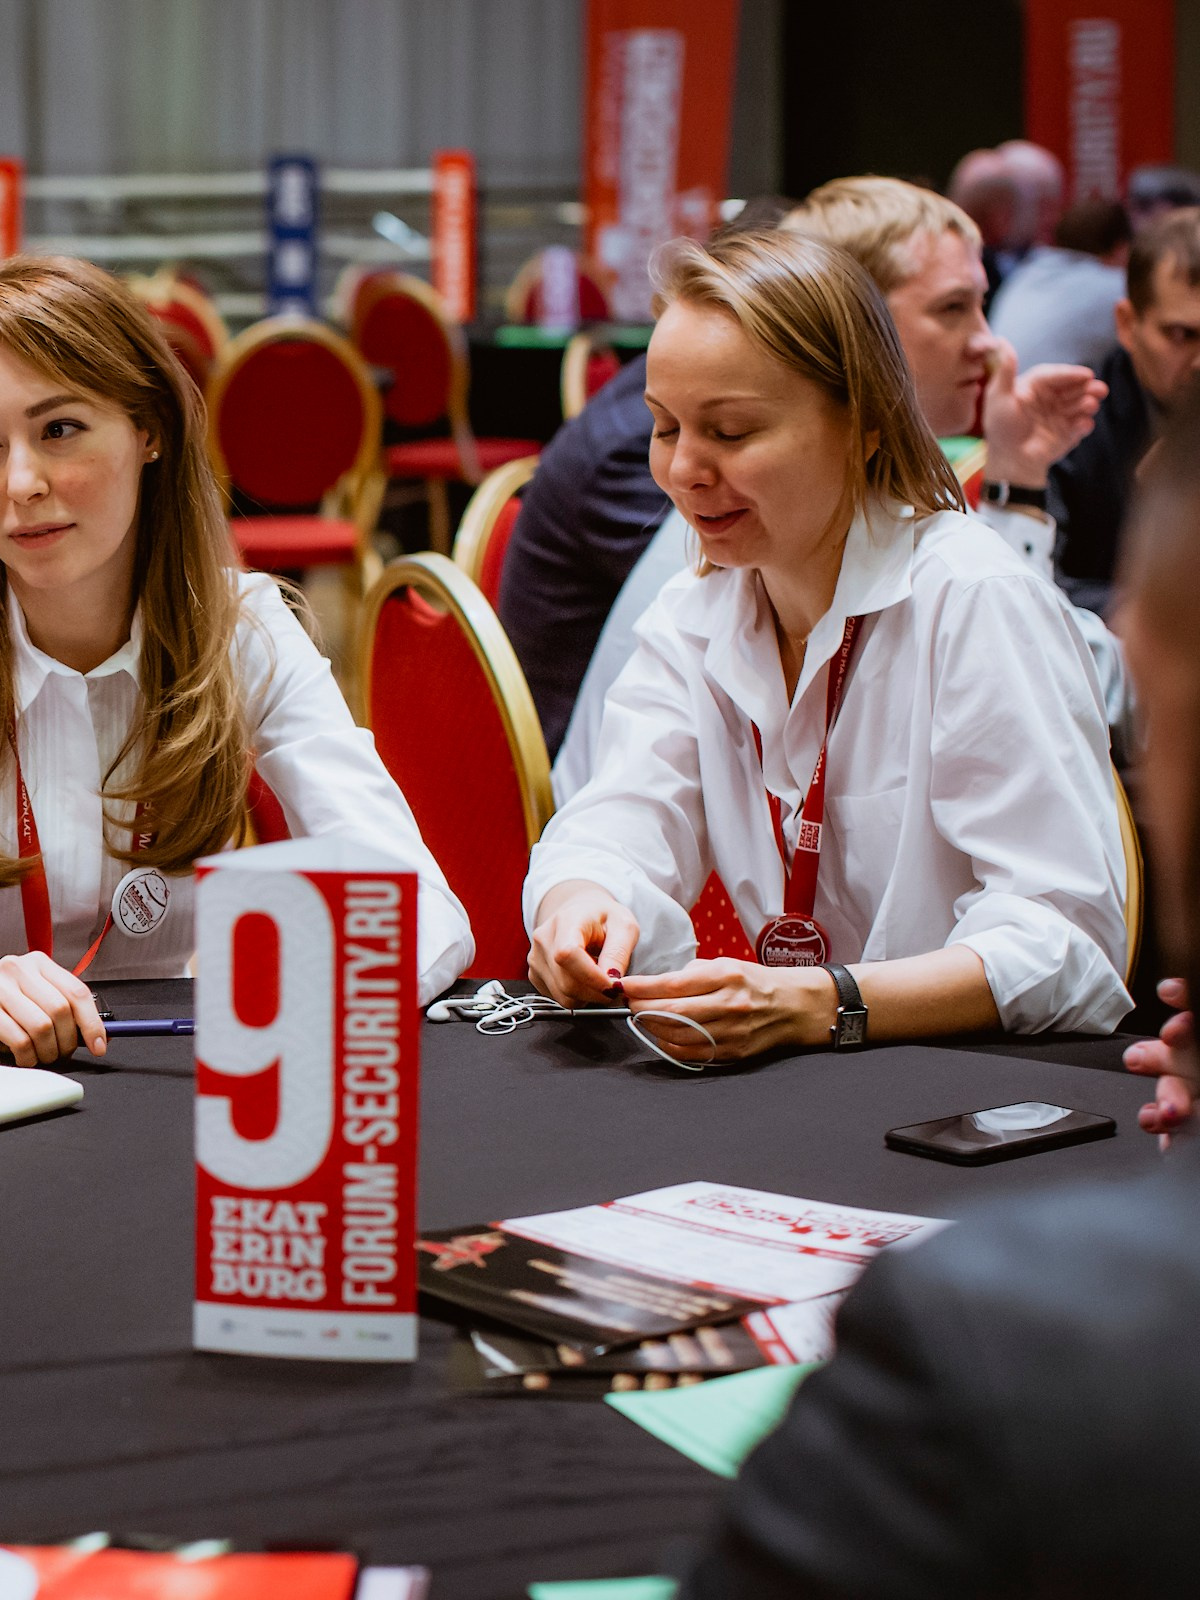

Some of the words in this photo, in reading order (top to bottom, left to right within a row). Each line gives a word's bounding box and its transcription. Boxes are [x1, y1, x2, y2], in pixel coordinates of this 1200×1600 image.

[194, 868, 337, 1191] 9
[341, 880, 402, 1307] FORUM-SECURITY.RU
[211, 1196, 327, 1235] EKAT
[211, 1230, 326, 1269] ERIN
[211, 1263, 326, 1303] BURG
